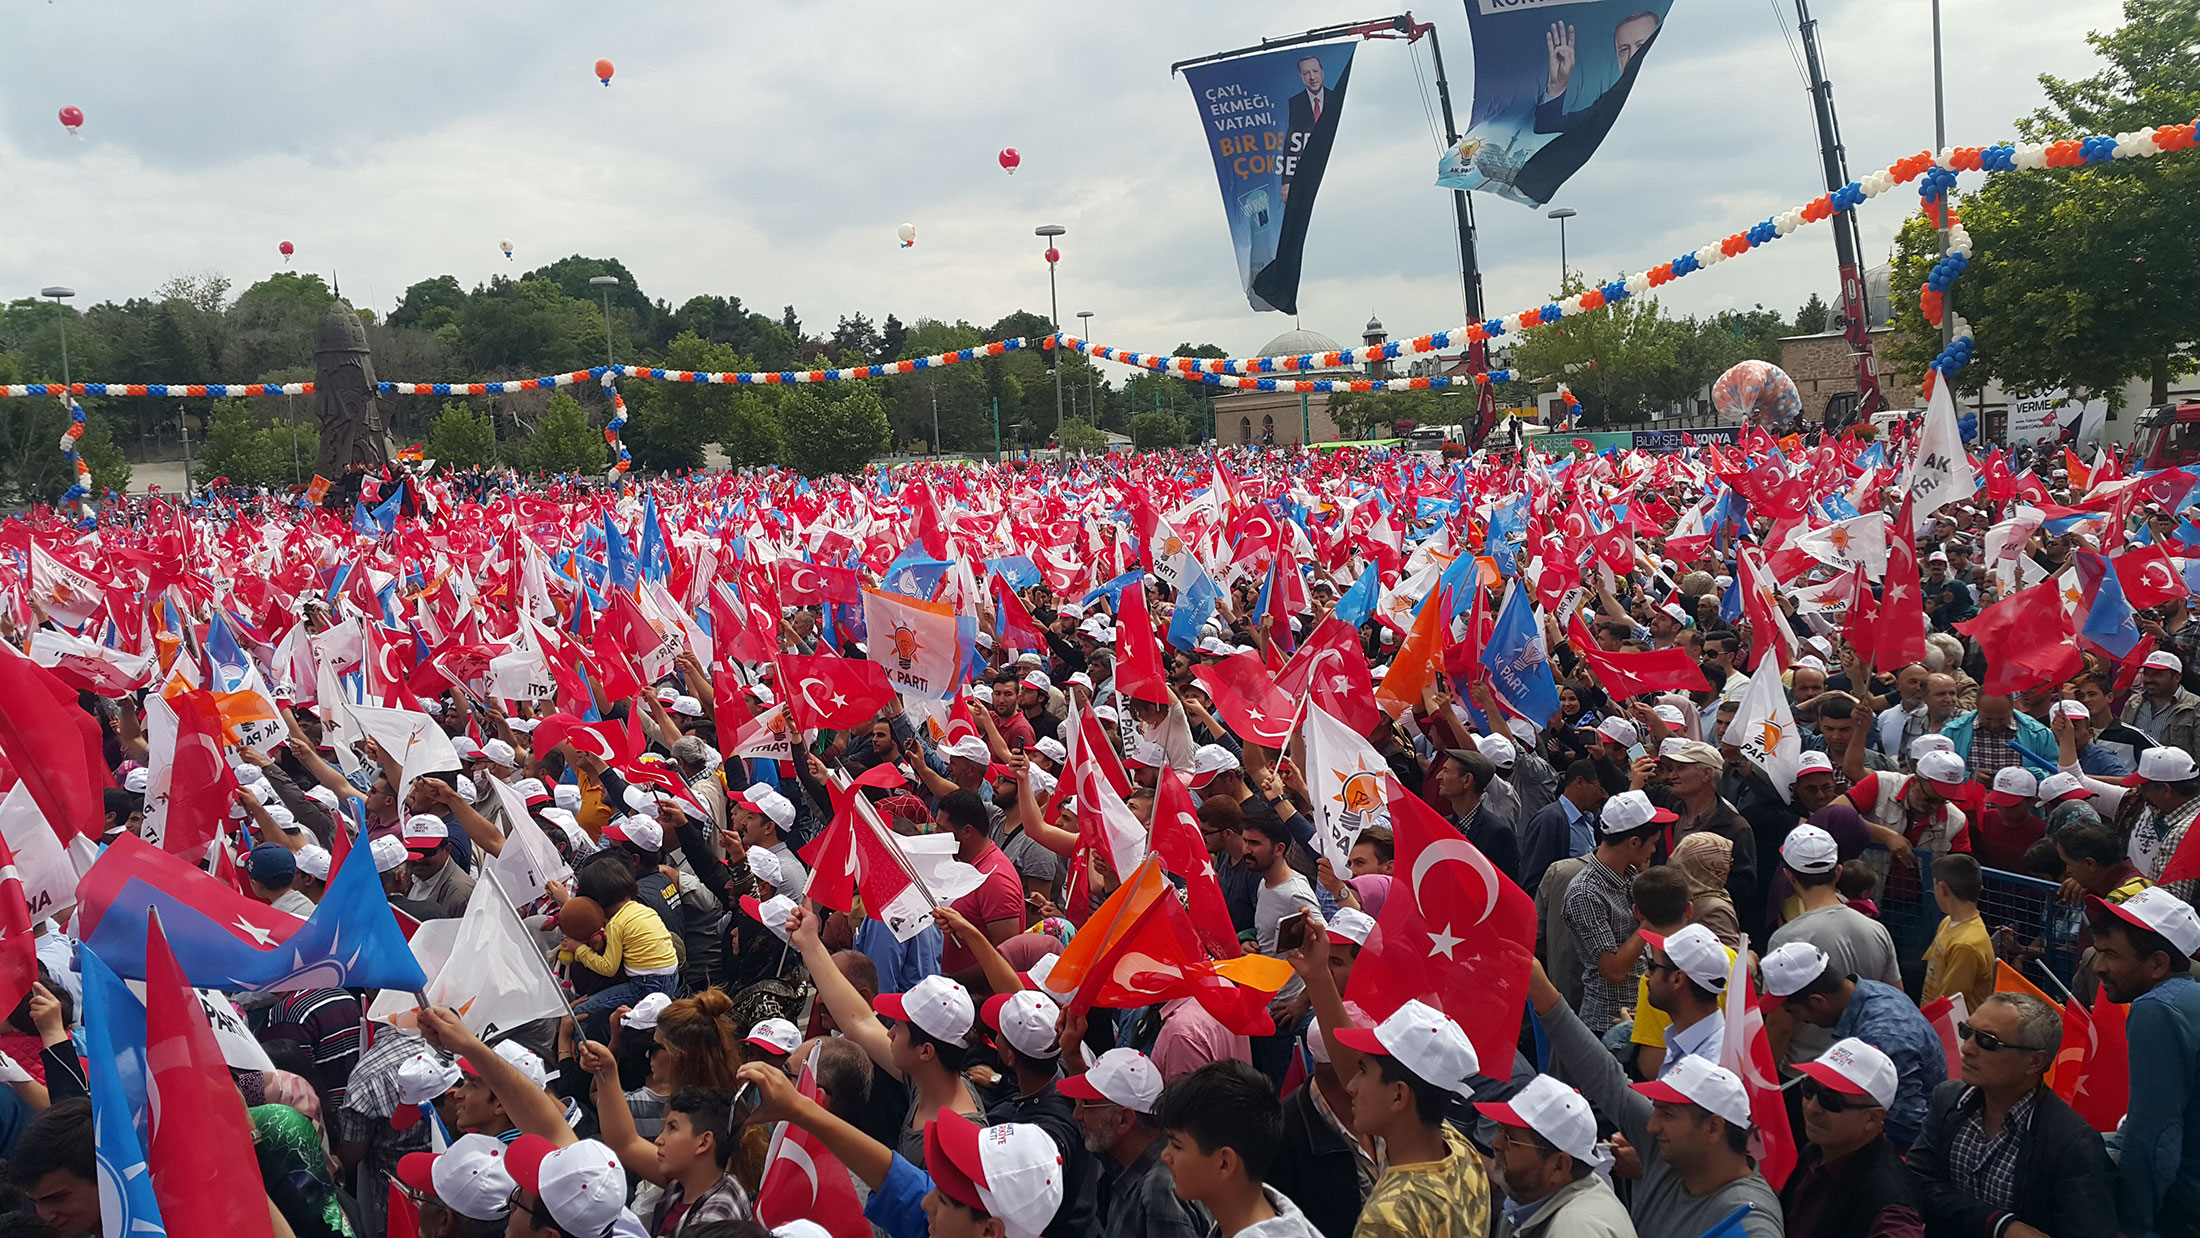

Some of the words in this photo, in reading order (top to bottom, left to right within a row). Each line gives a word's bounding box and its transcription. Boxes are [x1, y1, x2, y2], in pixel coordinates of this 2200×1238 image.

[1205, 84, 1248, 102] ÇAYI,
[1214, 112, 1277, 132] VATANI,
[1693, 433, 1732, 445] KONYA
[1924, 453, 1951, 473] AK
